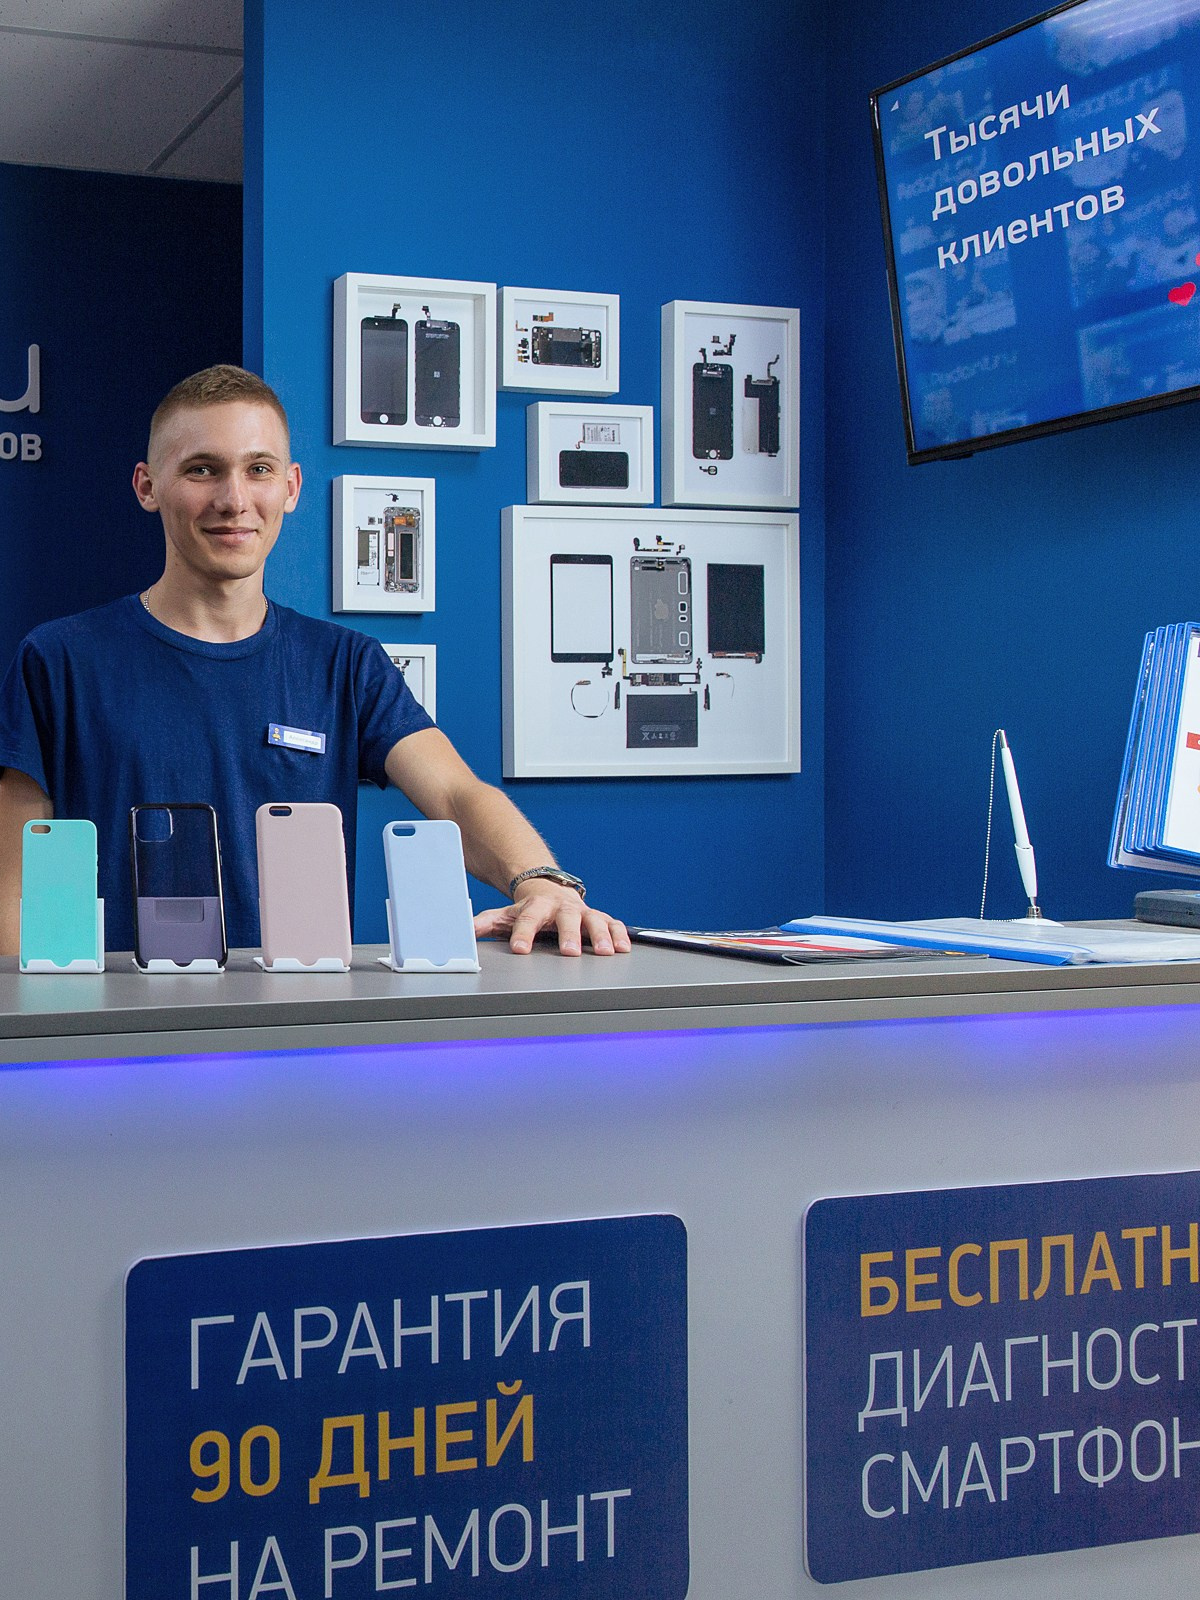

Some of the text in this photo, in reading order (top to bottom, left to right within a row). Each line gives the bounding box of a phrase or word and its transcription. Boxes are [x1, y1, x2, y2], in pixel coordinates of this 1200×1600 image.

[925, 84, 1069, 160] Тысячи
[932, 107, 1161, 220] довольных
[938, 186, 1125, 269] клиентов
[860, 1223, 1200, 1318] БЕСПЛАТН
[190, 1280, 591, 1389] ГАРАНТИЯ
[858, 1319, 1198, 1432] ДИАГНОСТ
[190, 1379, 534, 1504] 90 ДНЕЙ
[190, 1489, 632, 1600] НА РЕМОНТ
